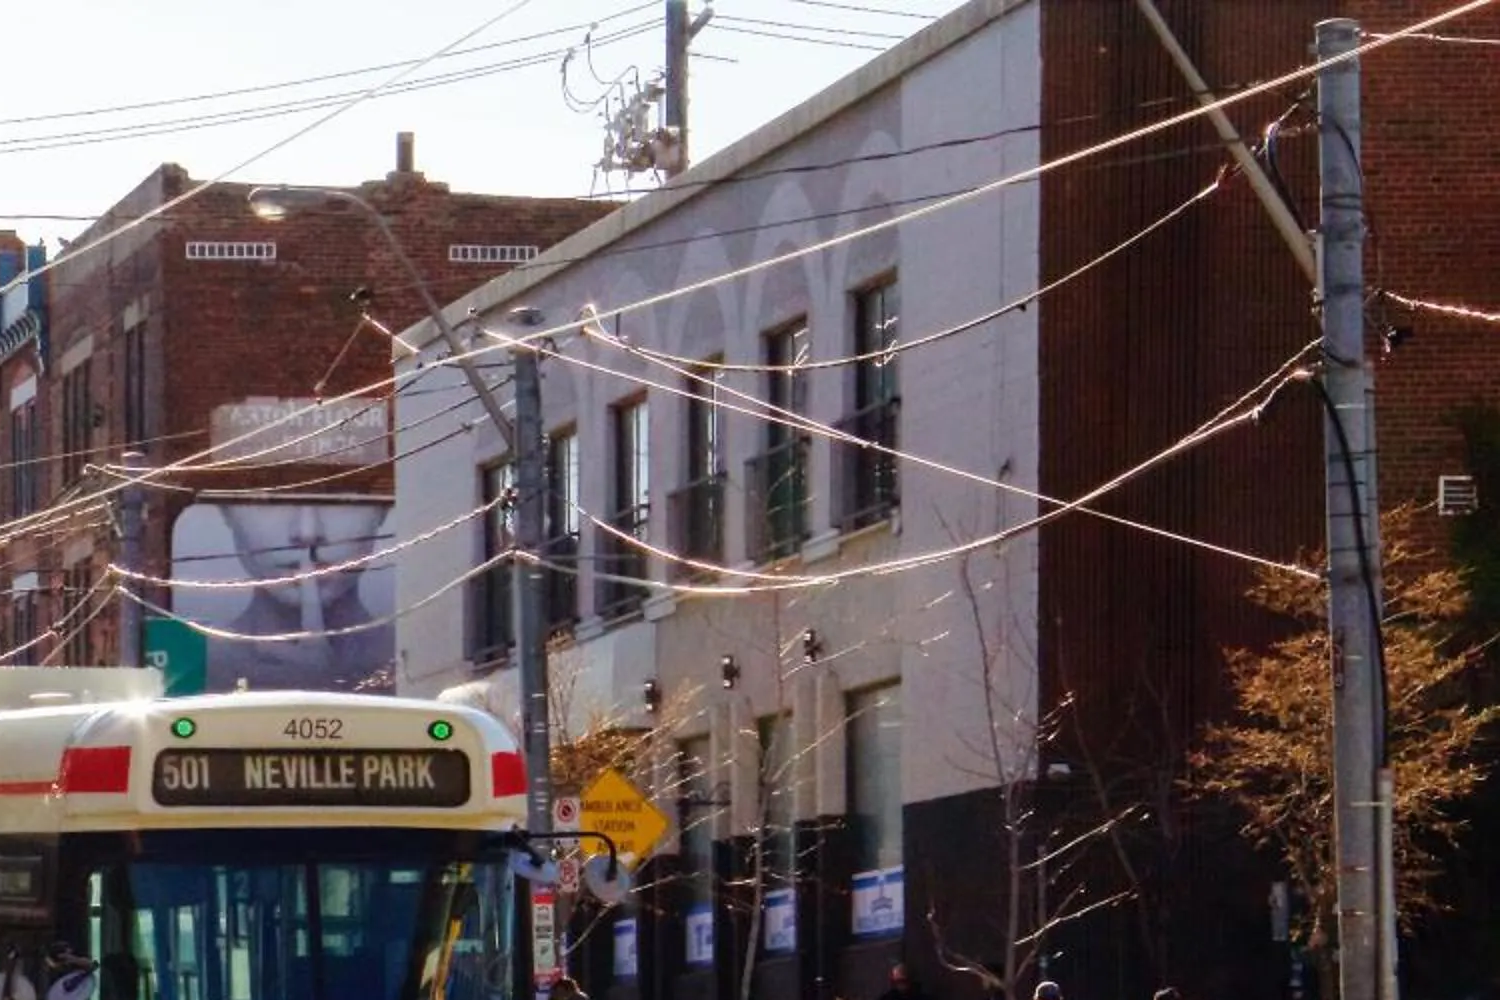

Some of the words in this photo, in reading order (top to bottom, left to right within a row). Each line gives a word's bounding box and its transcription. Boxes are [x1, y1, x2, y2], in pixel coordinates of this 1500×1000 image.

[283, 717, 342, 739] 4052
[163, 756, 209, 789] 501
[244, 755, 356, 789] NEVILLE
[363, 756, 435, 788] PARK
